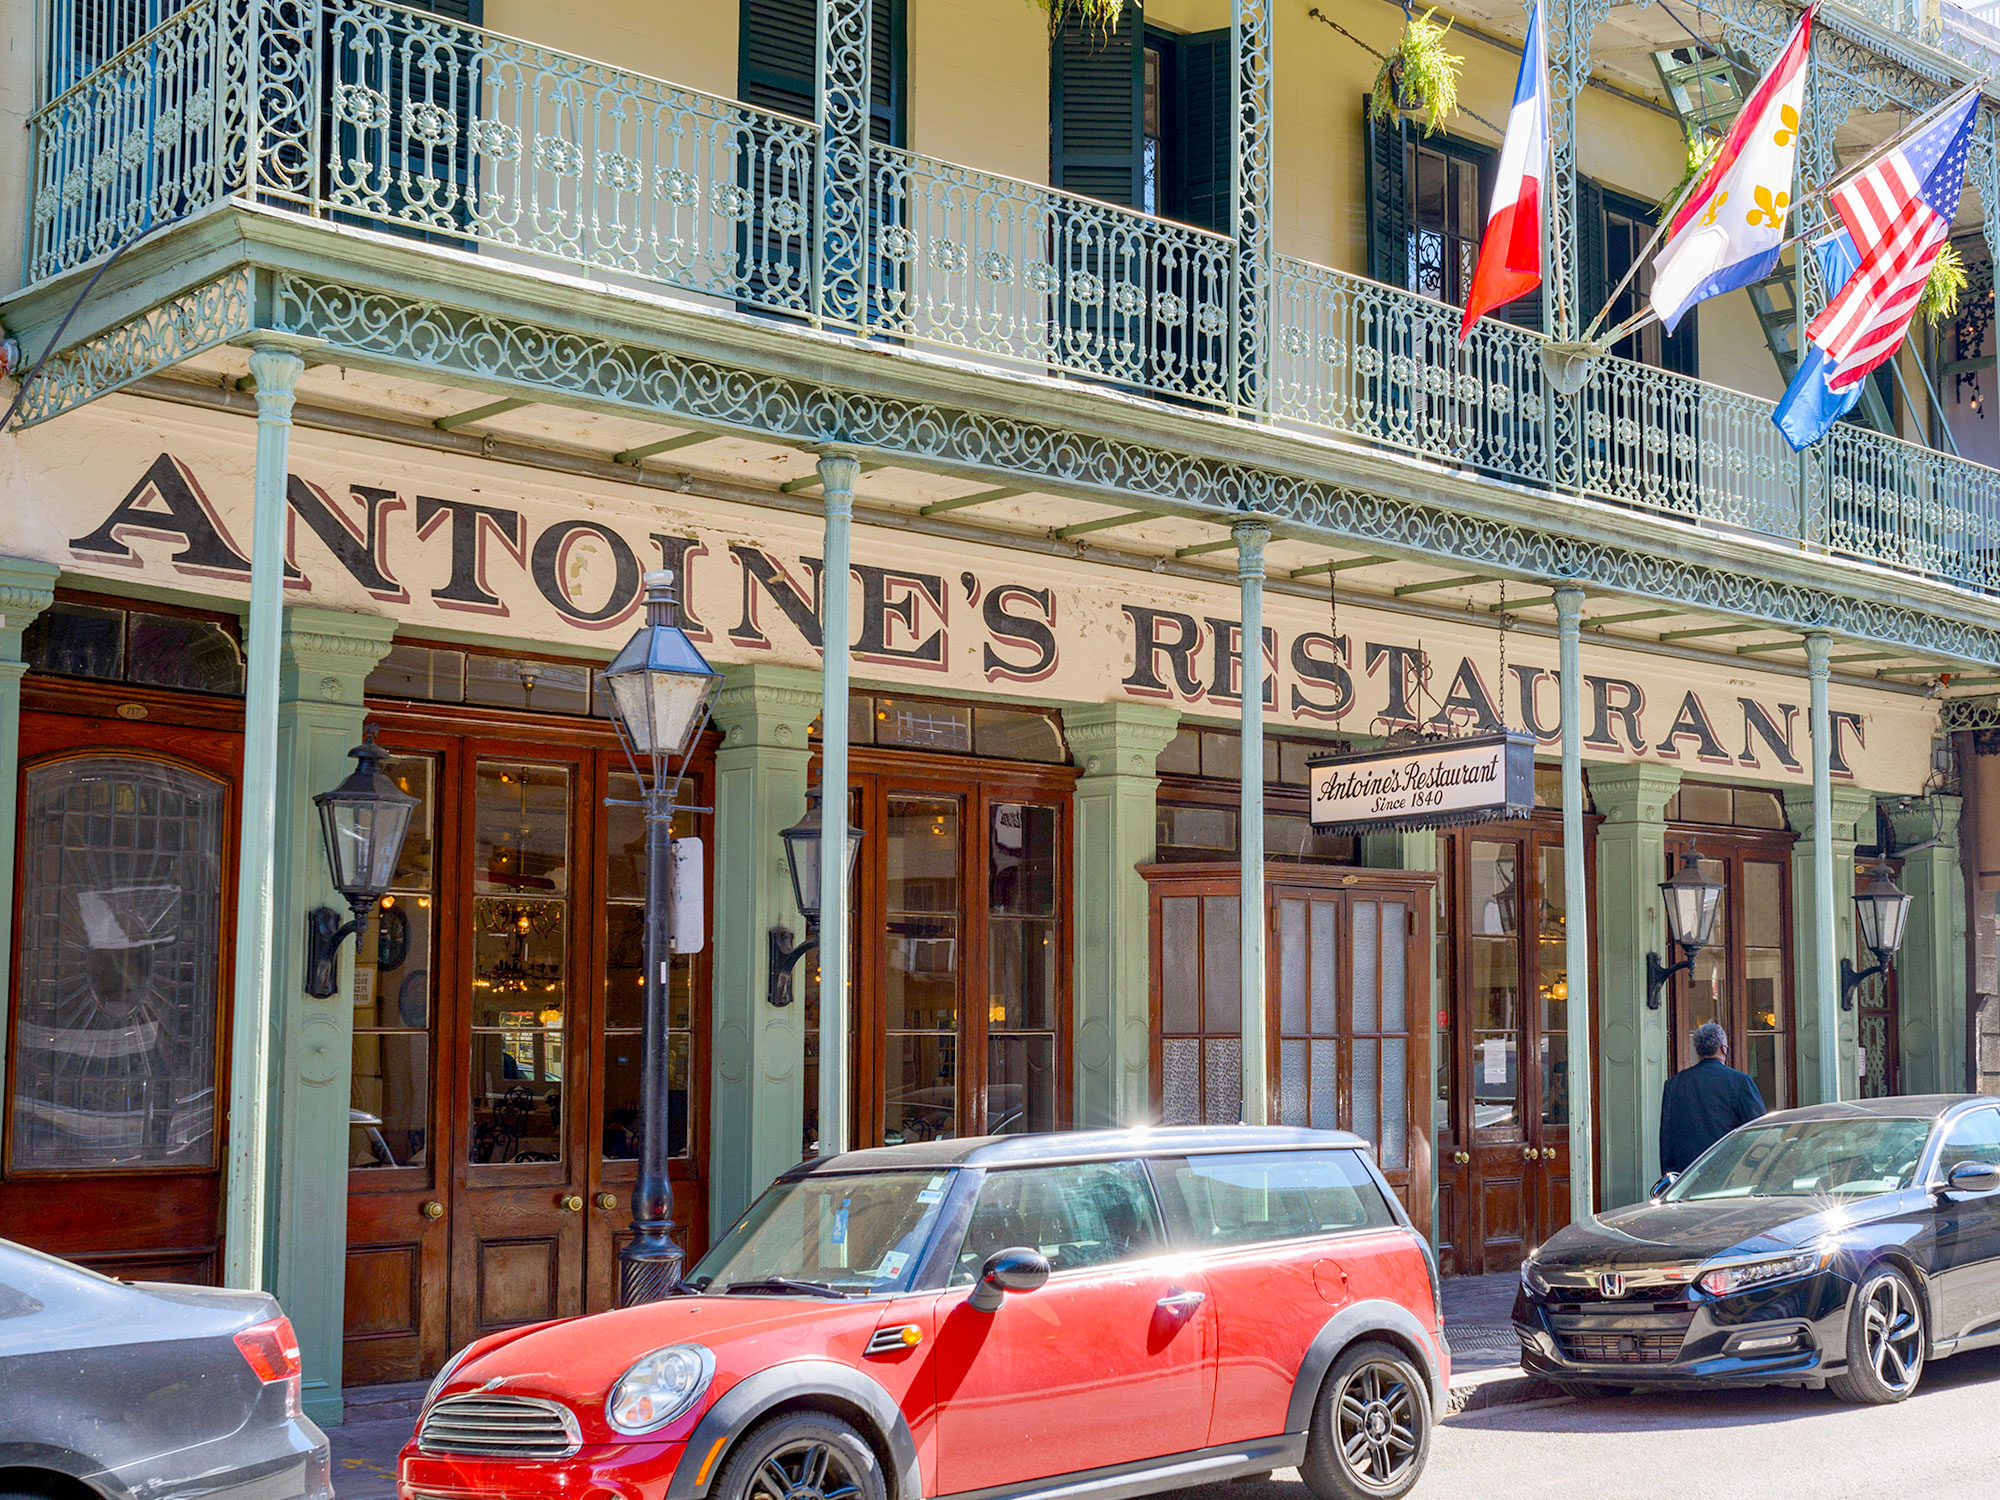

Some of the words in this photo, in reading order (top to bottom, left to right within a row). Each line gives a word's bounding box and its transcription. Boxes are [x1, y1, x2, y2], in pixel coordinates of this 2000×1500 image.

[69, 452, 1058, 683] ANTOINE'S
[1121, 604, 1866, 779] RESTAURANT
[1317, 768, 1401, 802] Antoine's
[1401, 754, 1499, 791] Restaurant
[1371, 796, 1406, 813] Since
[1411, 789, 1443, 807] 1840
